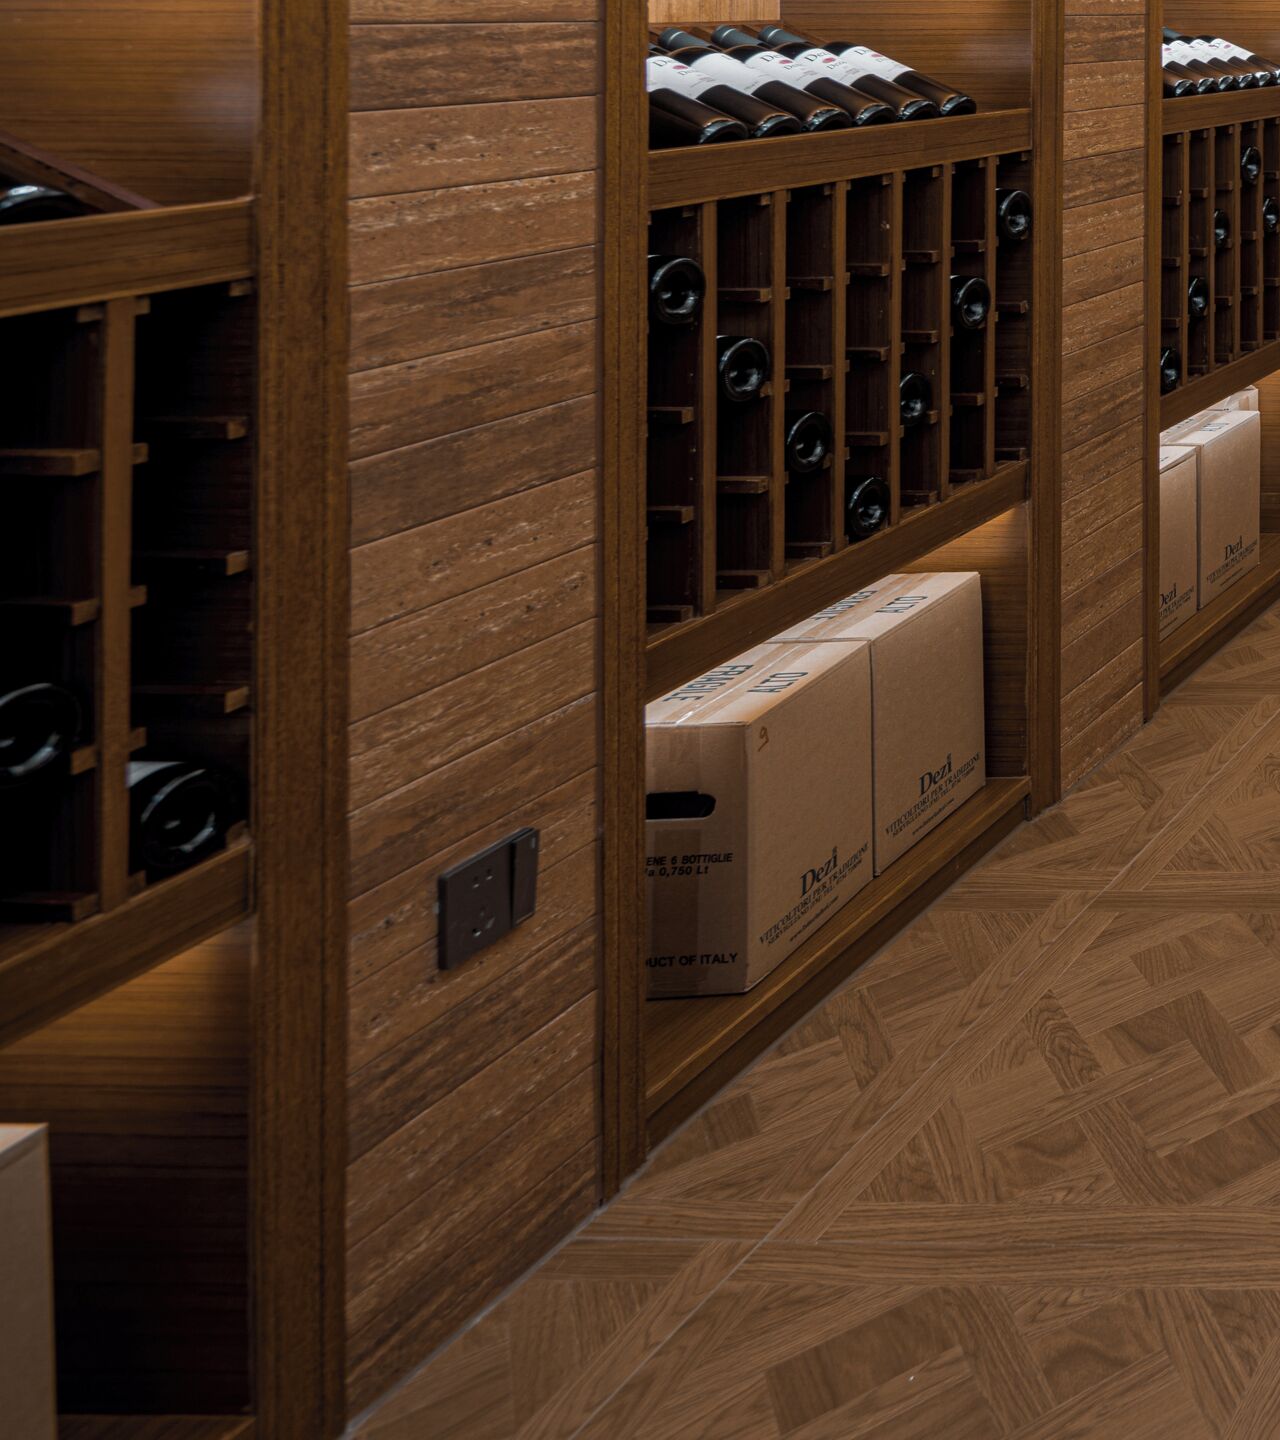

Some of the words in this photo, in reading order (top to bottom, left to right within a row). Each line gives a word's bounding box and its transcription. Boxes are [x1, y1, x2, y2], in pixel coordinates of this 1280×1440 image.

[875, 595, 928, 614] ALTO
[663, 664, 754, 702] FRAGILE
[747, 672, 808, 698] ALTO
[920, 752, 952, 797] Dezi
[646, 856, 667, 866] ENE
[671, 855, 677, 865] 6
[681, 853, 733, 865] BOTTIGLIE
[659, 866, 692, 878] 0,750
[800, 846, 838, 898] Dezi
[759, 894, 812, 944] VITICOLTORI
[646, 956, 675, 968] UCT
[678, 955, 697, 966] OF
[700, 952, 738, 965] ITALY
